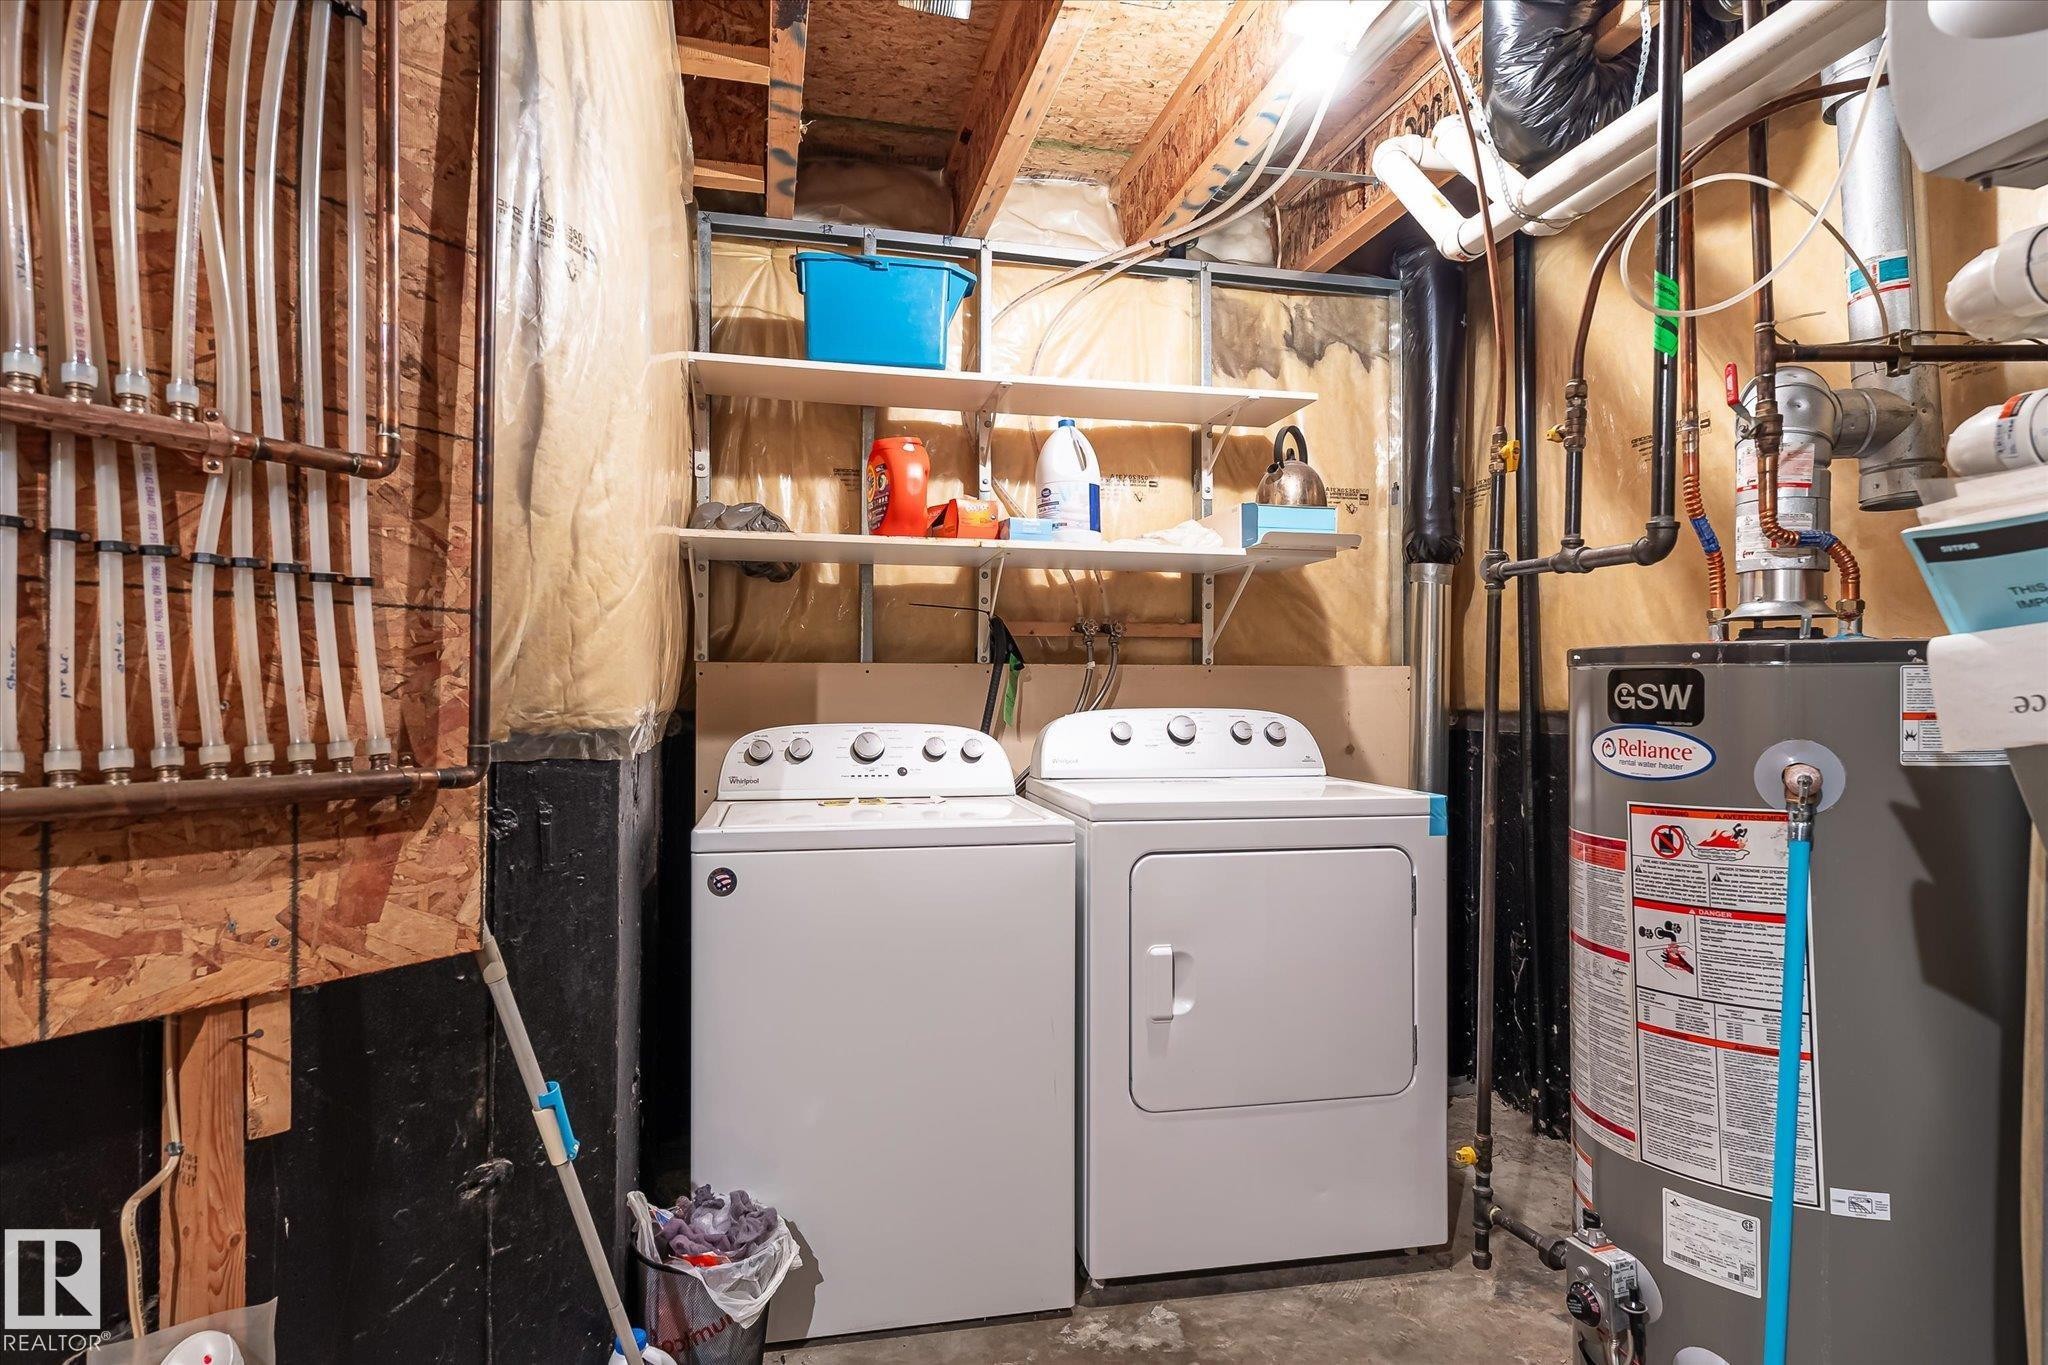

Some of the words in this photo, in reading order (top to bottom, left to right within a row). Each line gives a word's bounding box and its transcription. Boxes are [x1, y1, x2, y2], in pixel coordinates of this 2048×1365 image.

[2008, 582, 2047, 595] THIS
[1613, 682, 1694, 711] GSW
[1617, 738, 1693, 761] Reliance
[1618, 759, 1636, 767] rental
[1658, 762, 1684, 771] heater
[728, 776, 760, 786] Whirlpool
[1698, 908, 1733, 918] DANGER
